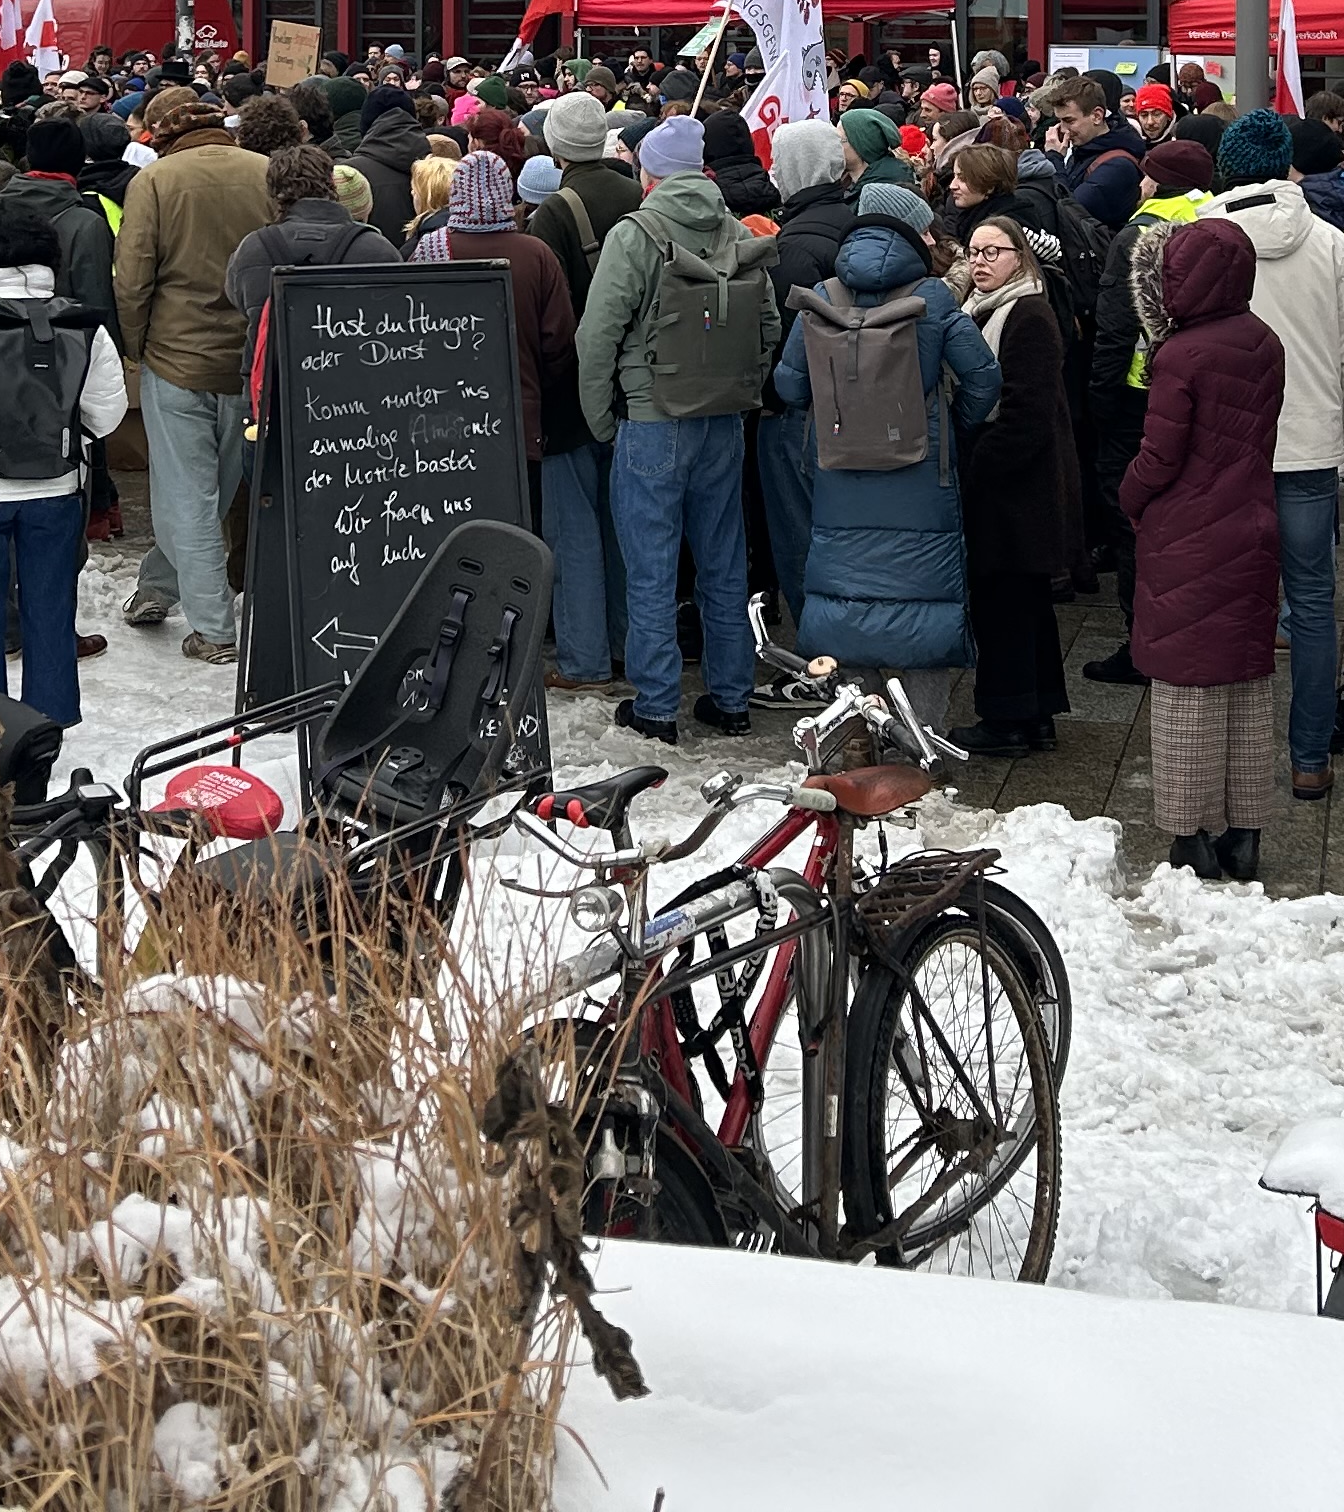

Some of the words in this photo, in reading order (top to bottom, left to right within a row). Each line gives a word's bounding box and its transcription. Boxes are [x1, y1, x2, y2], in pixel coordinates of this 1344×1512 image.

[311, 304, 371, 338] Hast
[375, 313, 406, 335] du
[405, 295, 486, 350] Hunger
[301, 350, 344, 371] oder
[358, 338, 429, 366] Durst
[305, 386, 371, 423] Komm
[381, 384, 449, 409] runter
[457, 380, 490, 399] ins
[309, 424, 399, 460] einmalige
[305, 469, 333, 492] der
[334, 493, 372, 535] Wir
[443, 496, 472, 515] uns
[331, 542, 360, 585] auf
[381, 535, 427, 566] euch
